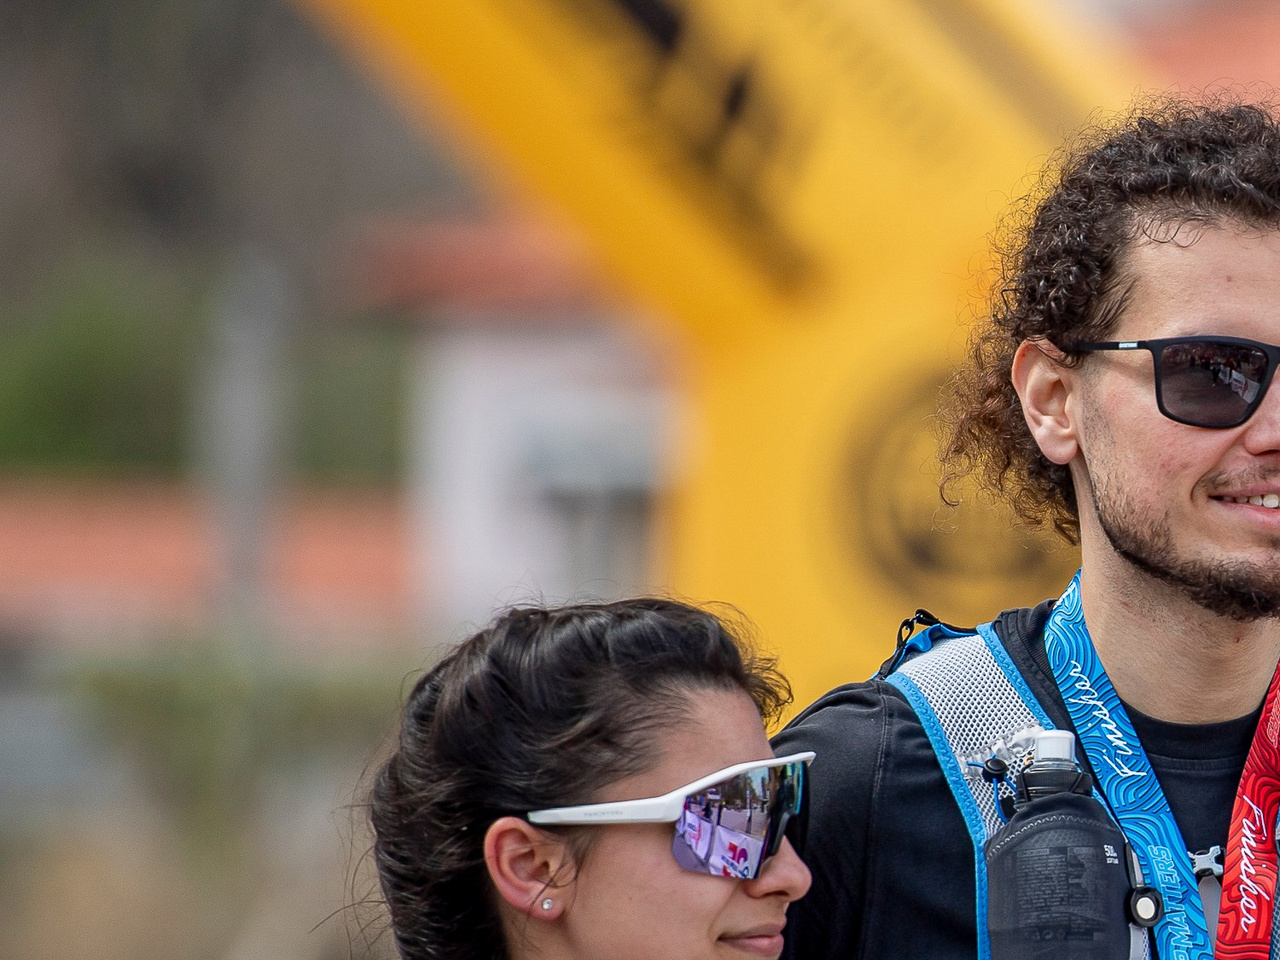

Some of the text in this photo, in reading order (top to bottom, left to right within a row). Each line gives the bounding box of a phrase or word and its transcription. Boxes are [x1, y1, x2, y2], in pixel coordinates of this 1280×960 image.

[1068, 659, 1147, 779] Finisher
[1147, 844, 1194, 949] MATTERS
[1240, 793, 1270, 935] Finisher
